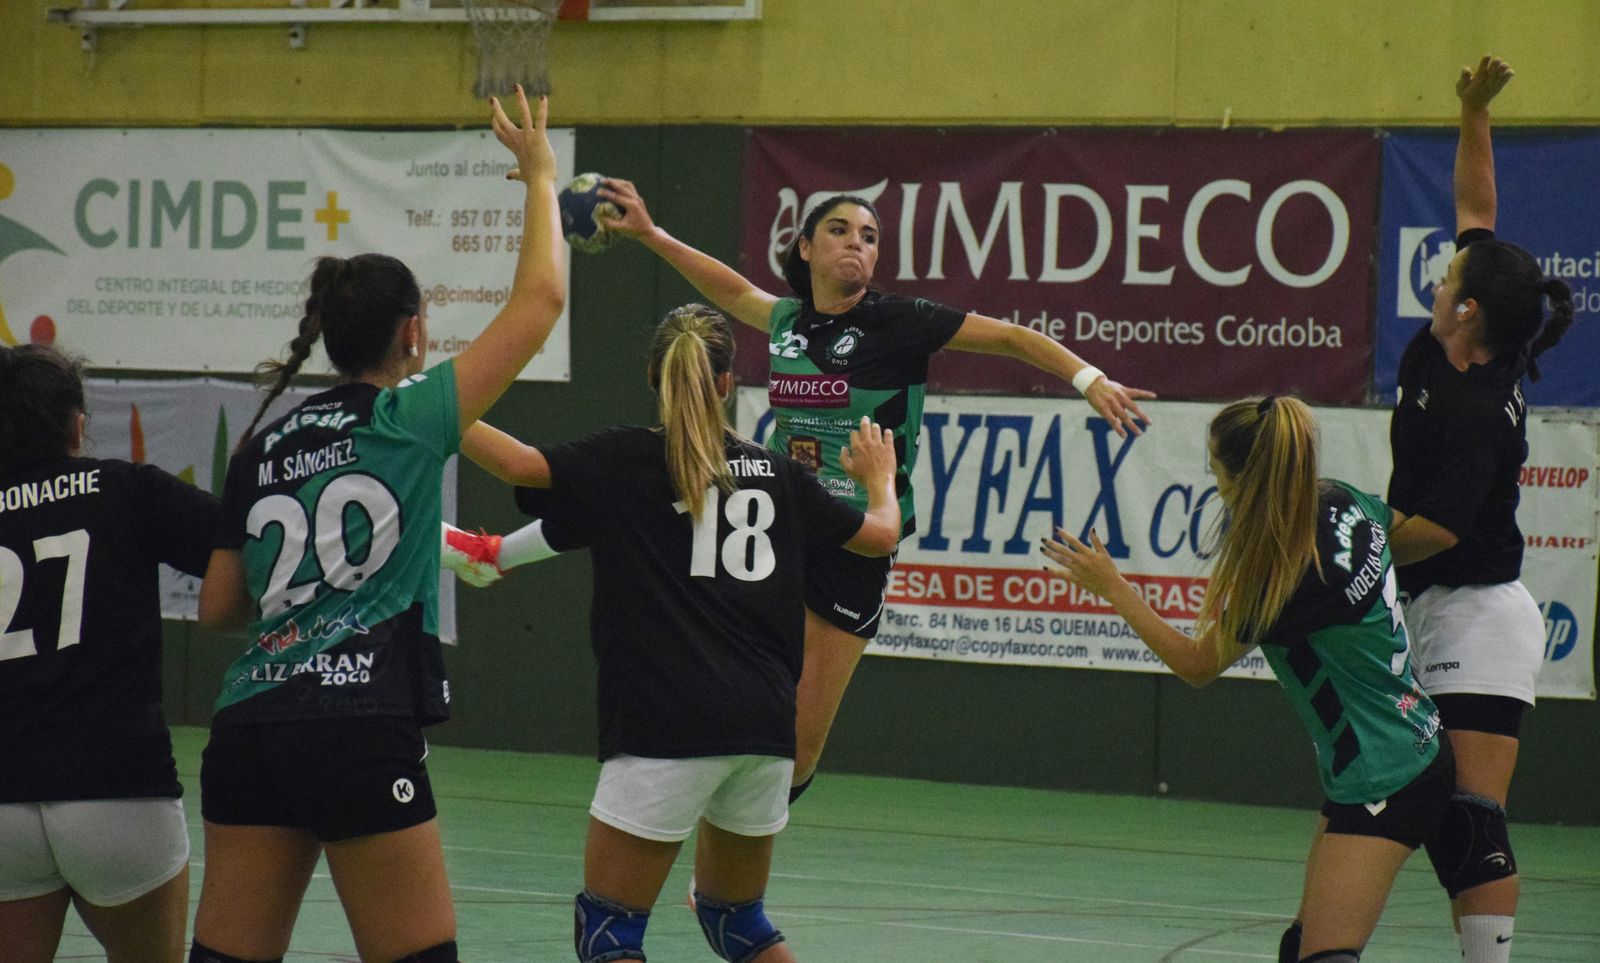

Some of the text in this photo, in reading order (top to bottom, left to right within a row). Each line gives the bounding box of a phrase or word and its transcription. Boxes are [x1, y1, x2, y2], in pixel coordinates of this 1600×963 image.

[406, 160, 449, 177] Junto
[454, 160, 468, 176] al
[451, 210, 479, 227] 957
[483, 210, 500, 227] 07
[506, 210, 523, 227] 56
[452, 235, 480, 251] 665
[484, 235, 500, 251] 07
[895, 178, 1351, 288] IMDECO
[95, 277, 153, 293] CENTRO
[157, 278, 226, 295] INTEGRAL
[231, 280, 250, 295] DE
[66, 299, 95, 315] DEL
[98, 300, 163, 317] DEPORTE
[167, 301, 177, 316] Y
[180, 302, 199, 317] DE
[203, 303, 221, 317] LA
[1029, 310, 1066, 341] de
[1075, 312, 1204, 349] Deportes
[1216, 314, 1343, 348] Córdoba
[769, 330, 809, 359] 22
[780, 380, 849, 396] IMDECO
[258, 438, 358, 487] M. SÁNCHEZ
[726, 455, 776, 477] TÍNEZ
[918, 412, 1150, 560] YFAX
[1519, 466, 1589, 489] DEVELOP
[672, 485, 776, 582] 18
[1527, 535, 1593, 549] HARP
[246, 473, 400, 622] 20
[885, 571, 1207, 613] ESA DE COPIARAS
[885, 609, 923, 628] Parc.
[928, 611, 947, 628] 84
[952, 614, 989, 632] Nave
[995, 616, 1011, 633] 16
[1015, 617, 1045, 635] LAS
[876, 630, 1089, 658] copyfaxcor@copyfaxcor.com
[321, 670, 371, 687] ZOCO
[1425, 660, 1460, 674] Kempa
